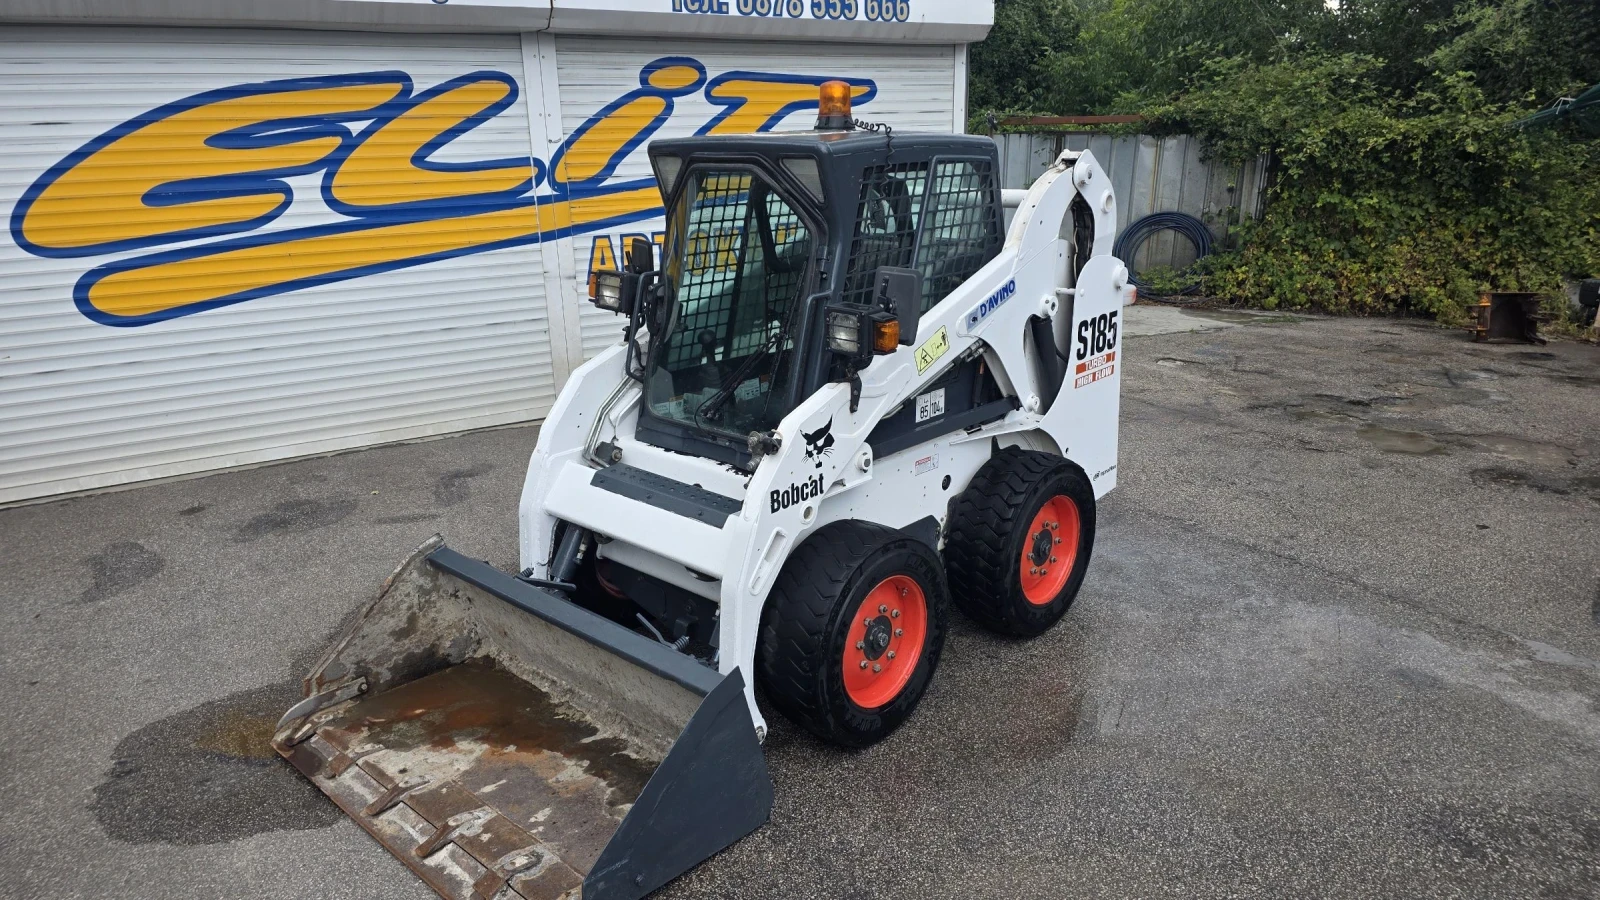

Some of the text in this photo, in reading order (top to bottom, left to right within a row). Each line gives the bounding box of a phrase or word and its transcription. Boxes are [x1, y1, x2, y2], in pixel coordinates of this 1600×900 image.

[811, 0, 858, 20] 555
[865, 0, 909, 22] 666
[980, 279, 1016, 318] D'AVINO
[1076, 310, 1118, 361] S185
[1085, 355, 1108, 371] TURBO
[1076, 365, 1113, 388] HIGH FLOW
[920, 404, 929, 419] 85
[770, 473, 824, 514] Bobcat
